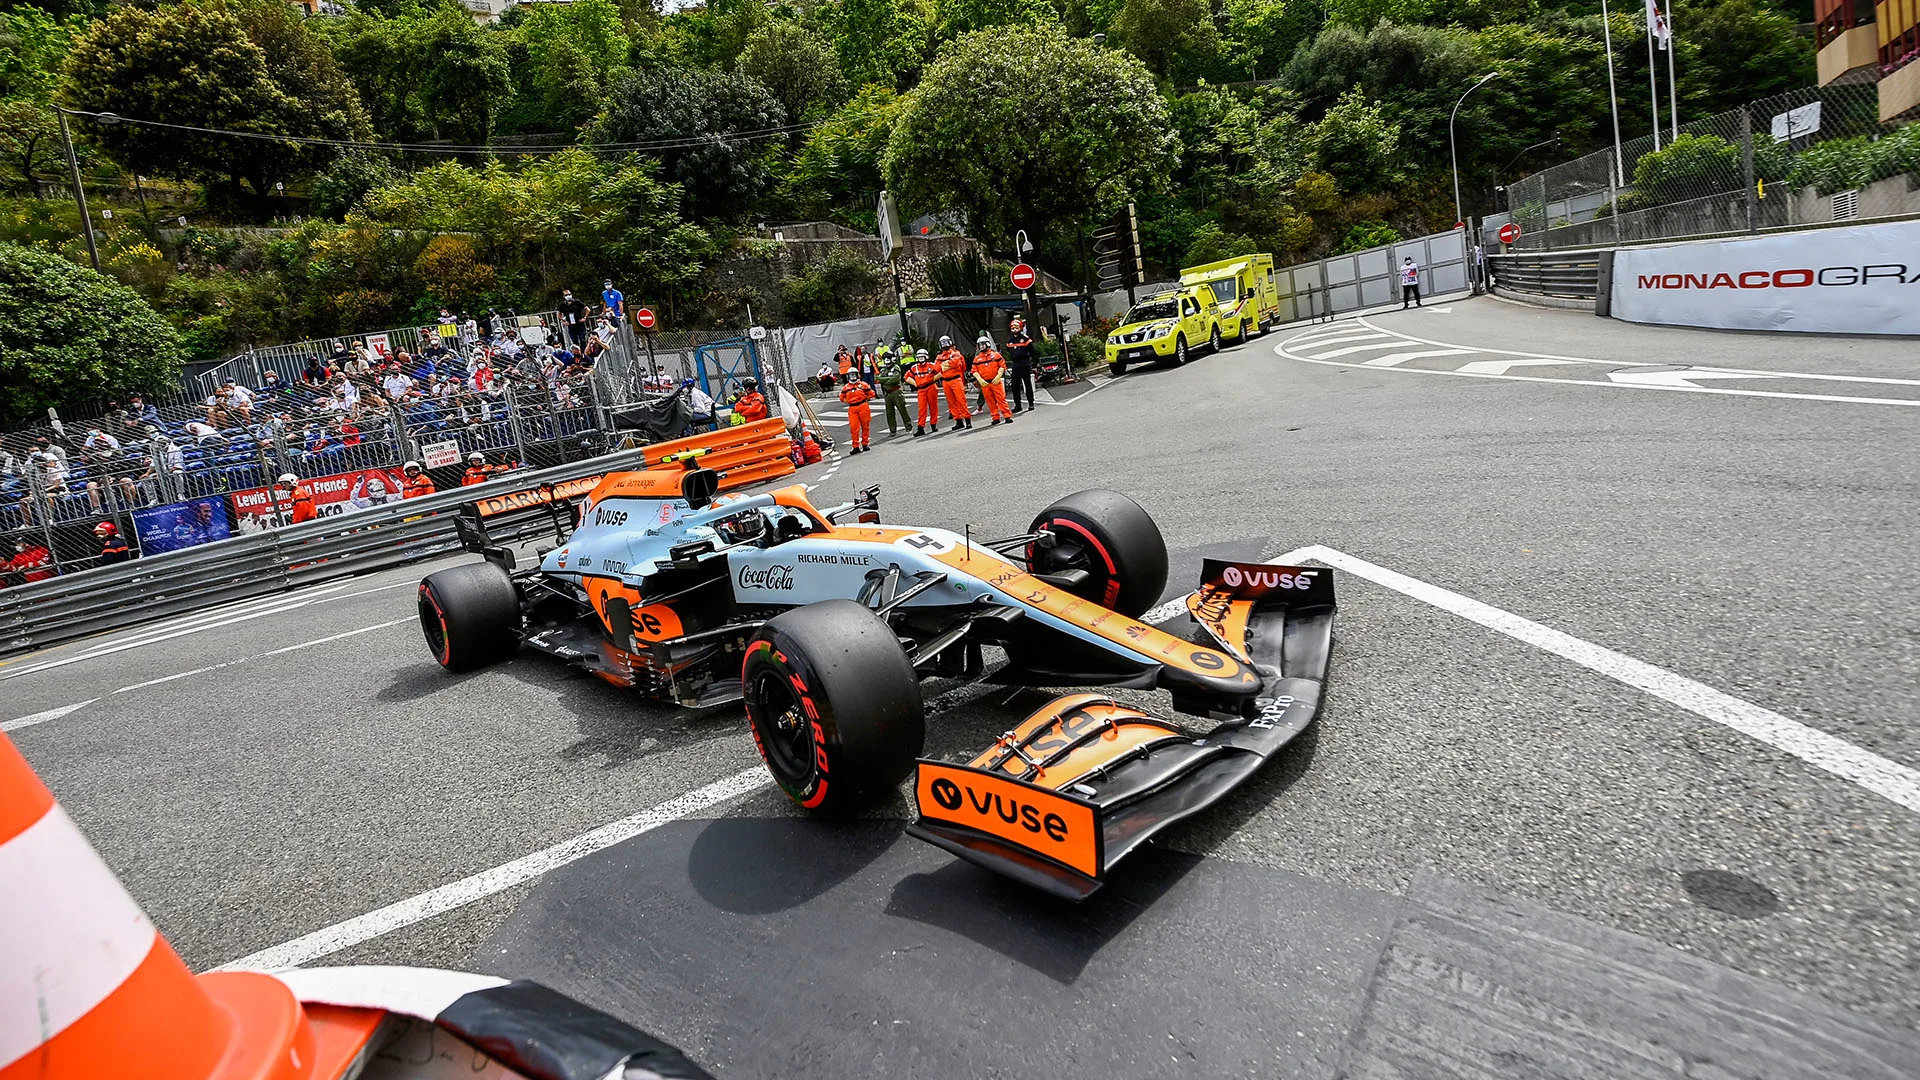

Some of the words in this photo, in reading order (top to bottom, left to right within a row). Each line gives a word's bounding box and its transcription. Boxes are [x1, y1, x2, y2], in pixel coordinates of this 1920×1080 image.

[236, 491, 267, 508] Lewis
[313, 479, 349, 495] France
[797, 553, 838, 565] RICHARD
[840, 555, 870, 566] MILLE
[789, 673, 829, 774] ZERO
[1248, 695, 1296, 730] FxPro
